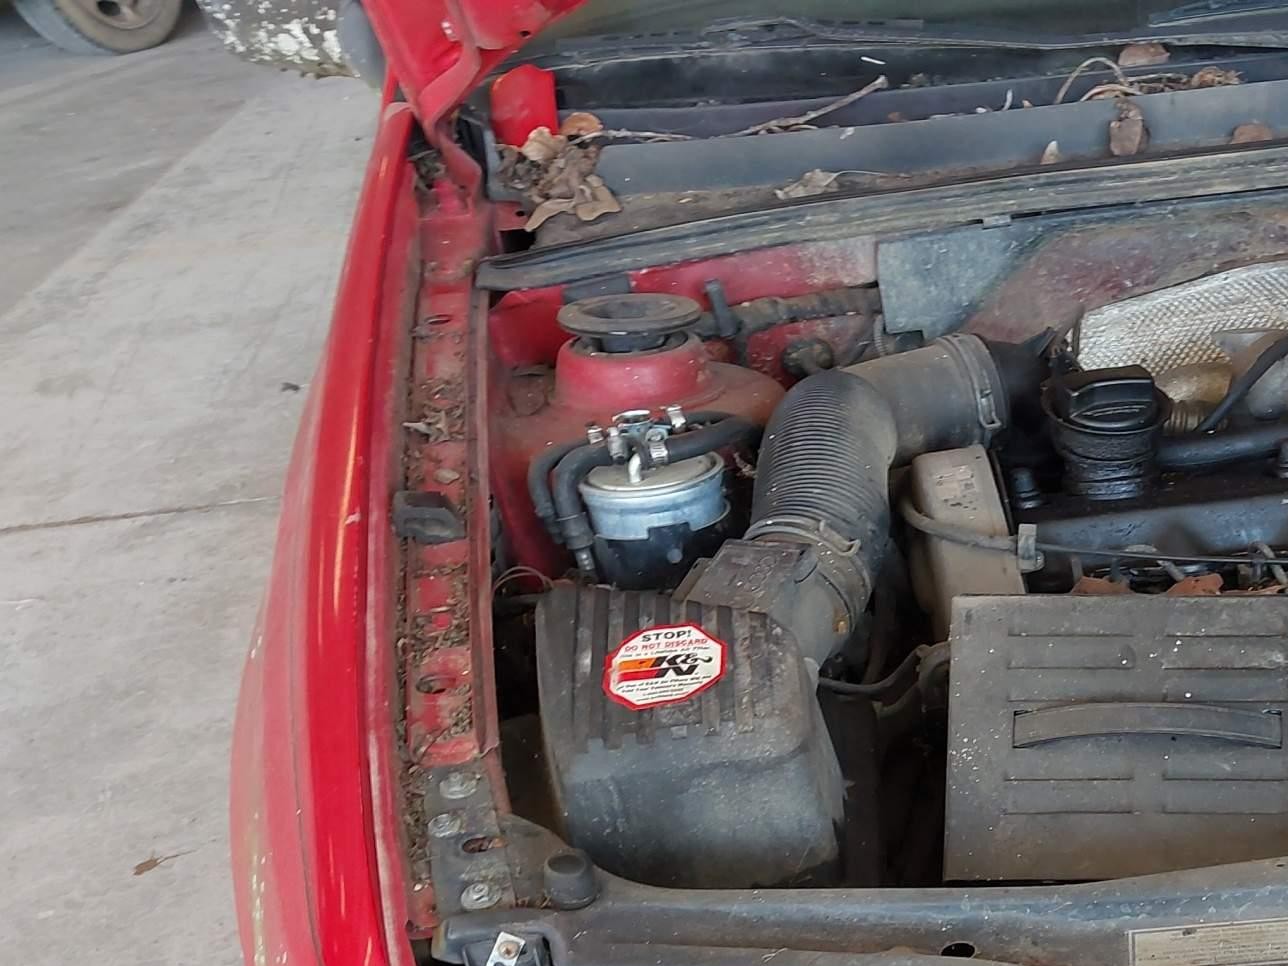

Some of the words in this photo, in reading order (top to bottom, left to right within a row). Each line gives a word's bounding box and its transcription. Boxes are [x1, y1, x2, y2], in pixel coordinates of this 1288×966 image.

[642, 630, 691, 642] STOP!
[625, 645, 638, 653] DO
[642, 643, 661, 651] NOT
[665, 639, 708, 648] DISCARD
